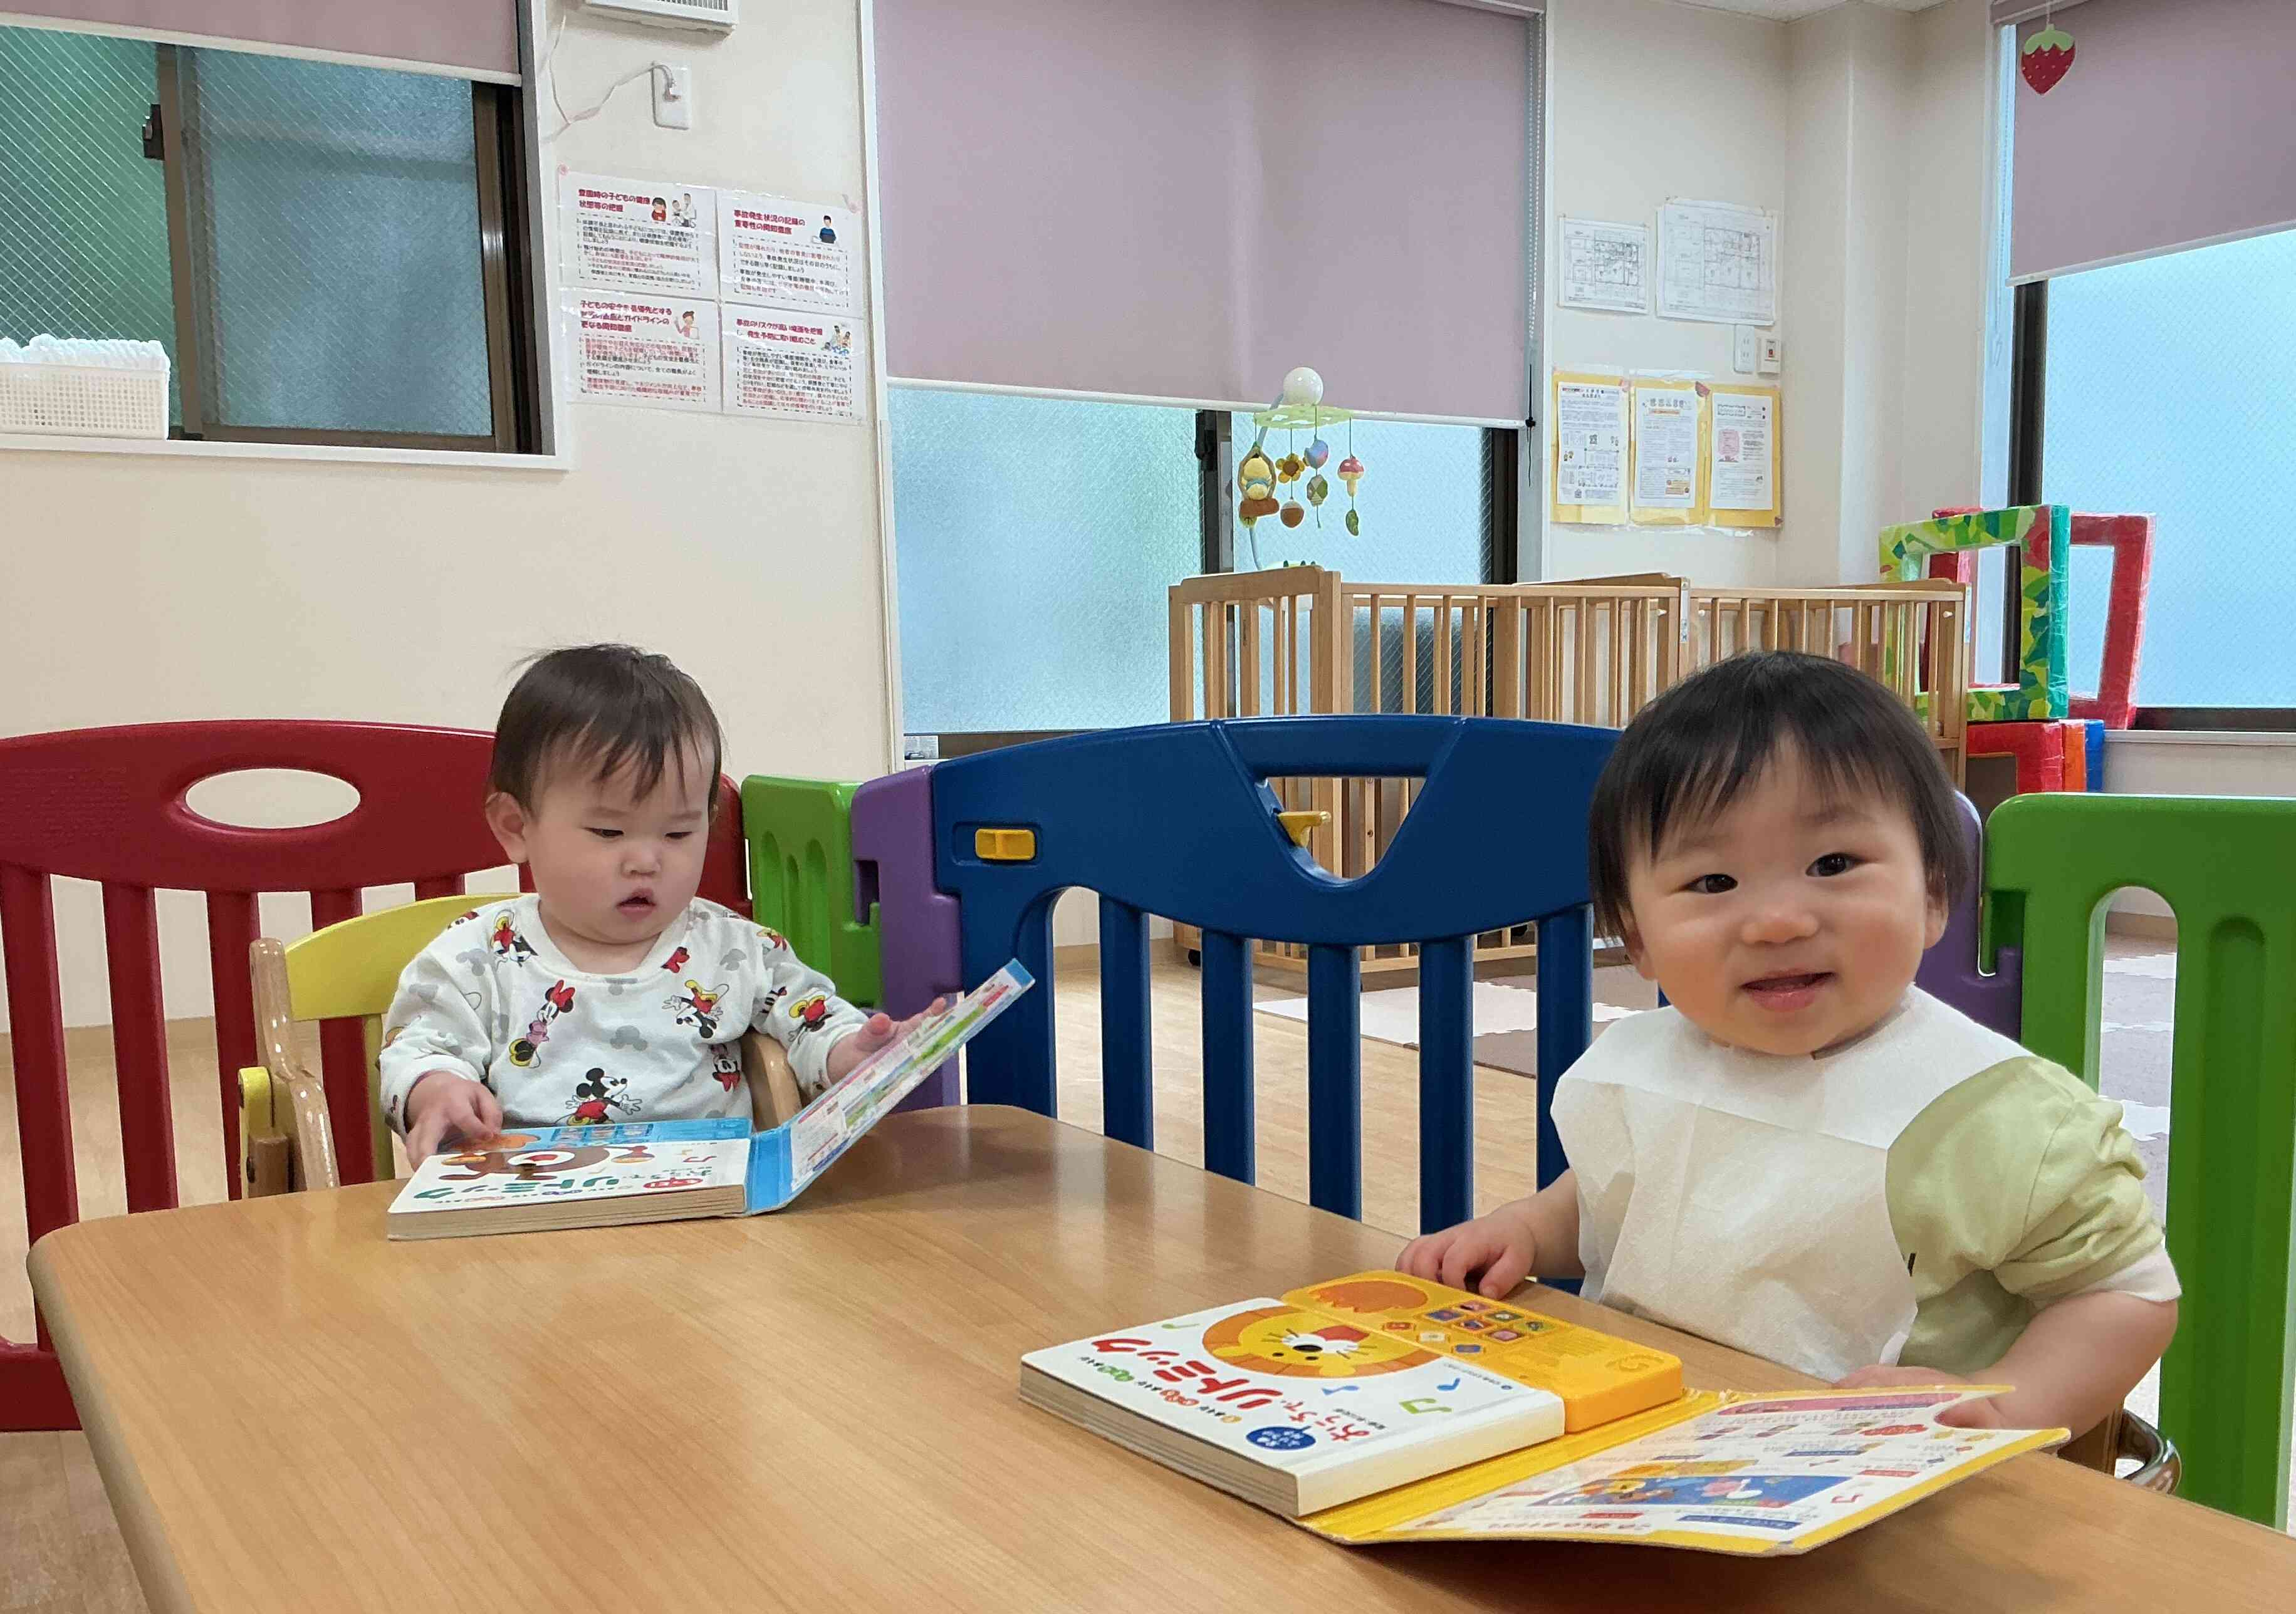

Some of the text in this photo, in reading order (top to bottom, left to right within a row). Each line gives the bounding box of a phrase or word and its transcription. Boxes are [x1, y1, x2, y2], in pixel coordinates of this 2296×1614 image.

[734, 210, 805, 226] 事故発生状況の記録の
[735, 220, 792, 234] 重要性の周知徹底
[737, 330, 817, 345] 発生予防に取り組むこと
[414, 1176, 619, 1199] リトミック
[1092, 1338, 1283, 1410] リトミック
[1281, 1398, 1370, 1441] おうちで
